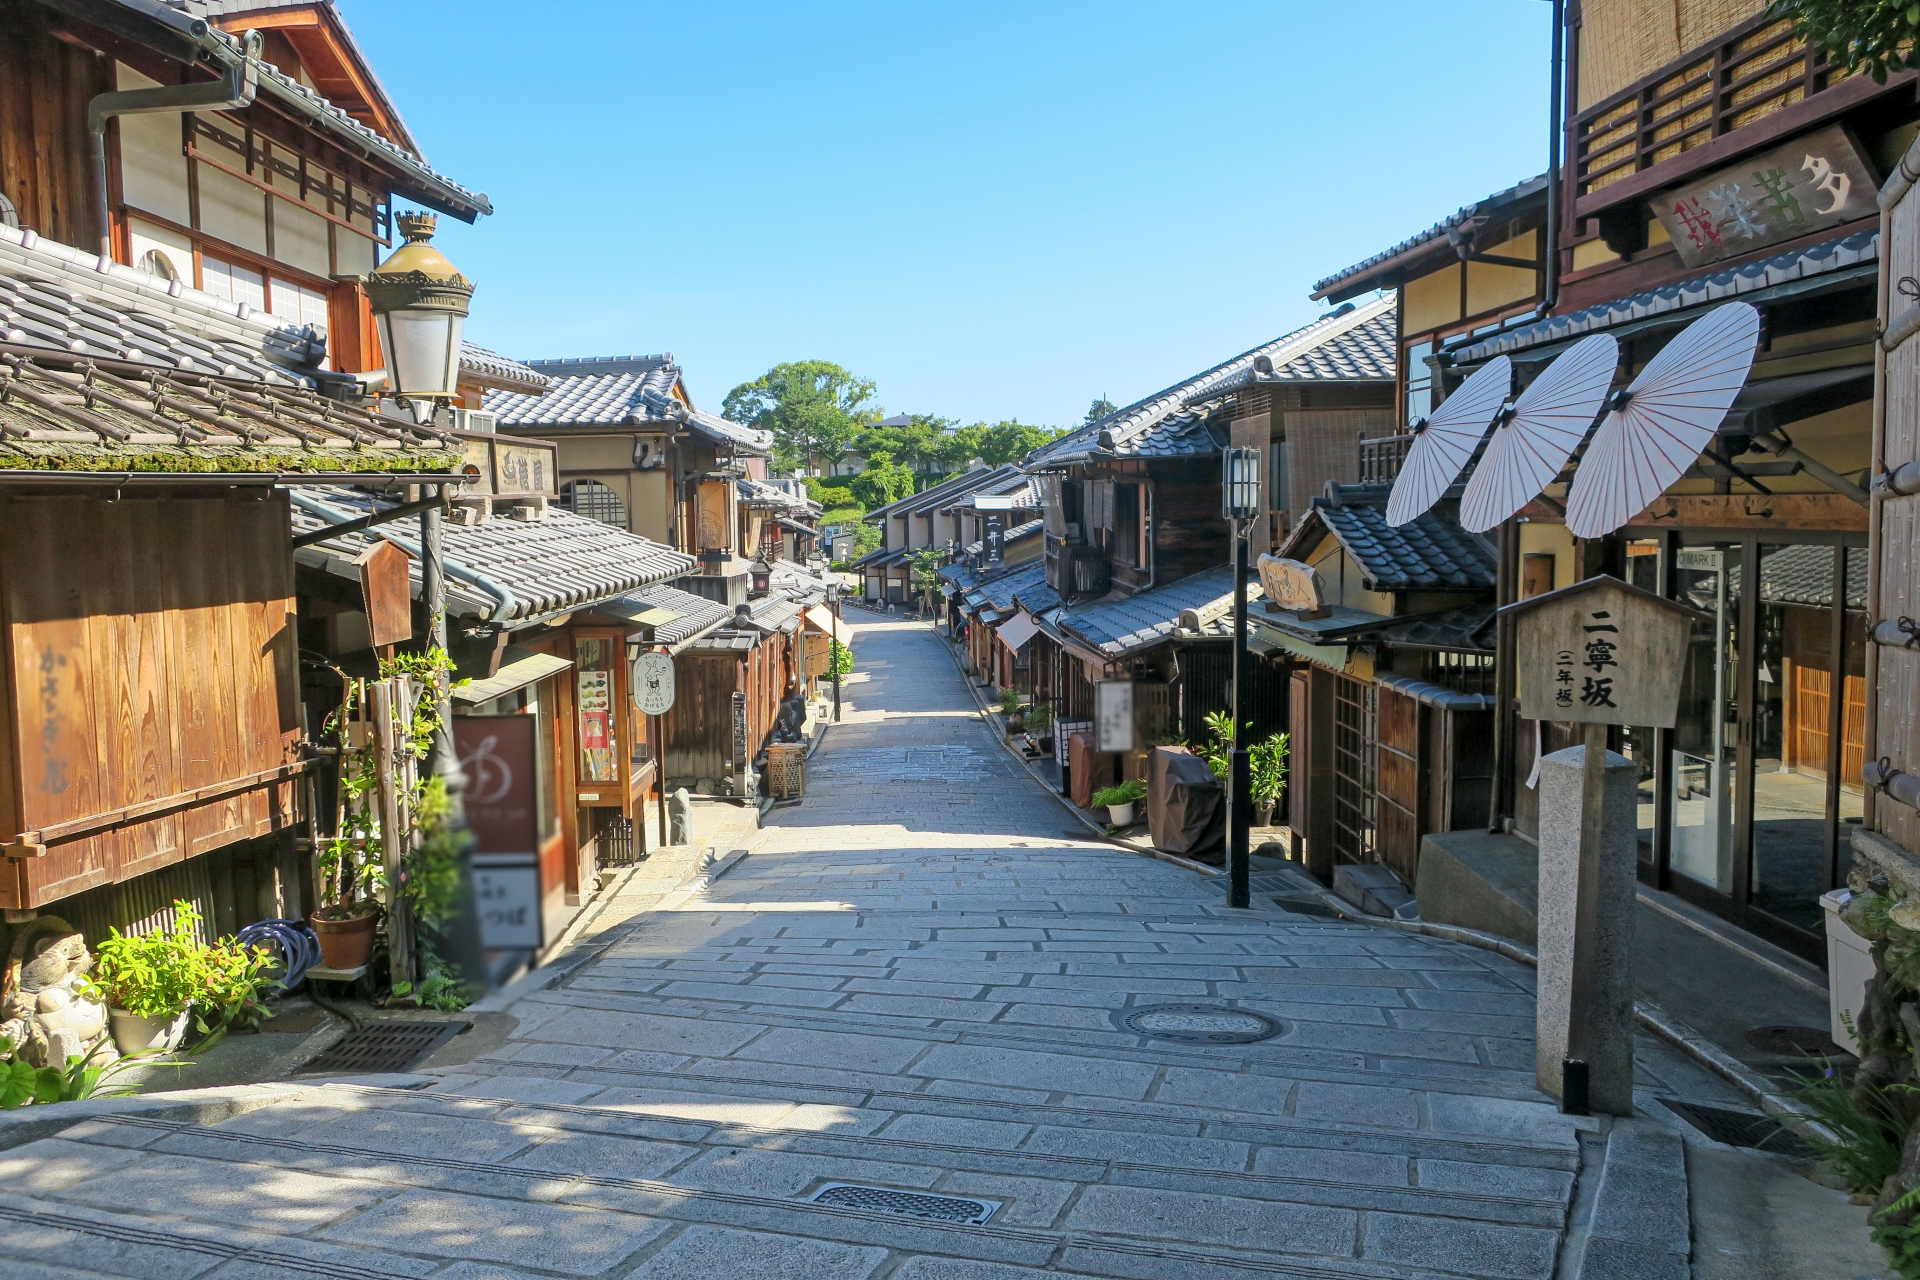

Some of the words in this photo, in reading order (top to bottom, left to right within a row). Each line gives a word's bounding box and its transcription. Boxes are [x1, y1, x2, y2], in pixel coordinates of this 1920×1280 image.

[1687, 553, 1710, 566] MARK
[1580, 610, 1619, 709] 二寧坂
